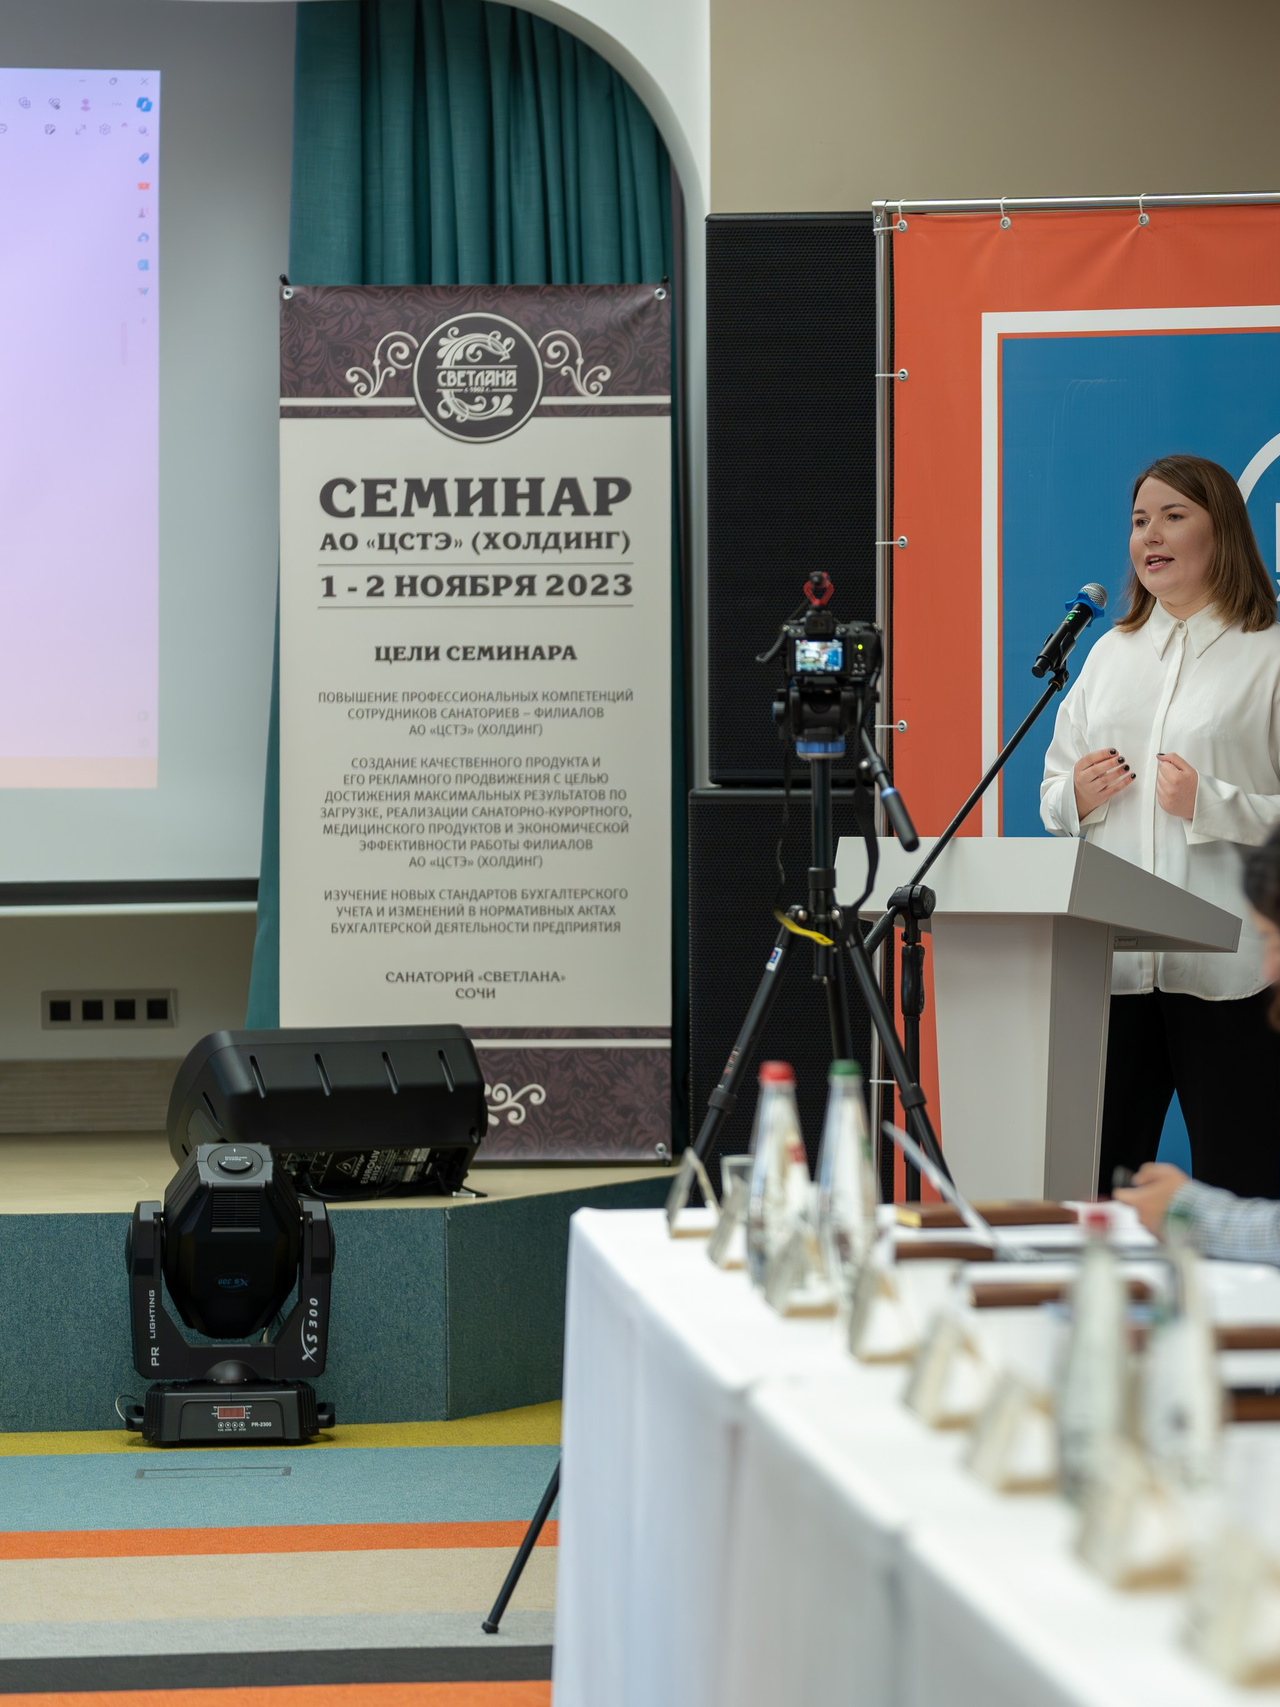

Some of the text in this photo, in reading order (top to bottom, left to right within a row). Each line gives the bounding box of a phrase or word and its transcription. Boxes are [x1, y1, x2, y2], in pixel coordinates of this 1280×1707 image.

[437, 370, 517, 387] СВЕТЛАНА
[319, 476, 632, 518] СЕМИНАР
[320, 530, 630, 555] АО «ЦСТЭ» (ХОЛДИНГ)
[322, 576, 336, 597] 1
[366, 575, 384, 597] 2
[395, 574, 537, 597] НОЯБРЯ
[546, 573, 633, 597] 2023
[375, 645, 577, 664] ЦЕЛИ СЕМИНАРА
[319, 688, 634, 704] ПОВЫШЕНИЕ ПРОФЕССИОНАЛЬНЫХ КОМПЕТЕНЦИЙ
[348, 708, 437, 721] СОТРУДНИКОВ
[441, 707, 519, 719] САНАТОРИЕВ
[534, 707, 604, 719] ФИЛИАЛОВ
[409, 723, 543, 737] АО «ЦСТЭ» (ХОЛДИНГ)
[351, 756, 601, 771] СОЗДАНИЕ КАЧЕСТВЕННОГО ПРОДУКТА И
[344, 772, 609, 787] ЕГО РЕКЛАМНОГО ПРОДВИЖЕНИЯ С ЦЕЛЬЮ
[325, 789, 627, 804] ДОСТИЖЕНИЯ МАКСИМАЛЬНЫХ РЕЗУЛЬТАТОВ ПО
[321, 805, 632, 821] ЗАГРУЗКЕ, РЕАЛИЗАЦИИ САНАТОРНО-КУРОРТНОГО,
[323, 820, 629, 837] МЕДИЦИНСКОГО ПРОДУКТОВ И ЭКОНОМИЧЕСКОЙ
[360, 839, 593, 851] ЭФФЕКТИВНОСТИ РАБОТЫ ФИЛИАЛОВ
[409, 855, 543, 869] АО «ЦСТЭ» (ХОЛДИНГ)
[324, 888, 628, 902] ИЗУЧЕНИЕ НОВЫХ СТАНДАРТОВ БУХГАЛТЕРСКОГО
[337, 904, 616, 917] УЧЕТА И ИЗМЕНЕНИЙ В НОРМАТИВНЫХ АКТАХ
[331, 920, 621, 935] БУХГАЛТЕРСКОЙ ДЕЯТЕЛЬНОСТИ ПРЕДПРИЯТИЯ
[386, 969, 474, 983] САНАТОРИЙ
[455, 988, 495, 999] СОЧИ
[360, 1150, 380, 1184] EUROLIV
[308, 1297, 319, 1329] 300
[151, 1346, 160, 1366] PR
